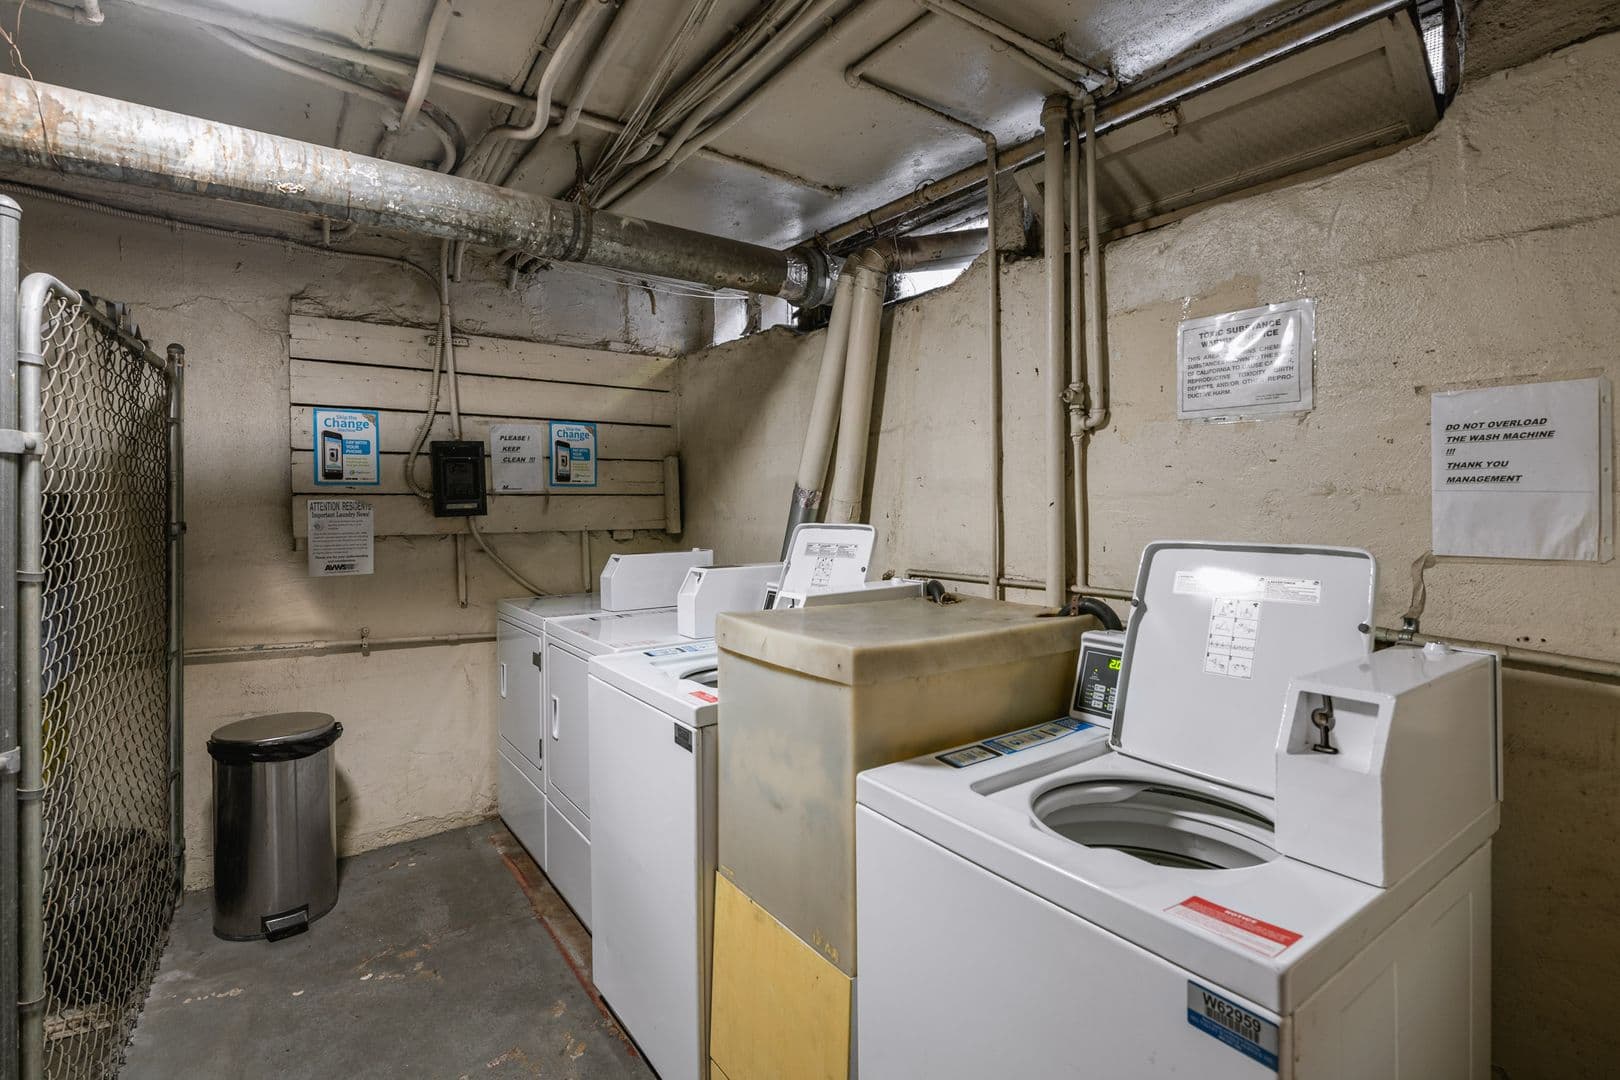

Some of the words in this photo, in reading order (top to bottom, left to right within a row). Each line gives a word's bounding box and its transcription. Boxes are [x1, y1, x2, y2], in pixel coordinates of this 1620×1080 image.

[323, 417, 370, 431] Change
[1445, 423, 1460, 431] DO
[1462, 422, 1486, 431] NOT
[1487, 418, 1548, 428] OVERLOAD
[556, 429, 590, 441] Change
[1446, 435, 1468, 443] THE
[1469, 433, 1501, 442] WASH
[1502, 430, 1556, 440] MACHINE
[1446, 461, 1483, 470] THANK
[1486, 460, 1510, 468] YOU
[1446, 474, 1523, 484] MANAGEMENT
[310, 501, 340, 511] ATTENTION
[1202, 991, 1262, 1034] W62959
